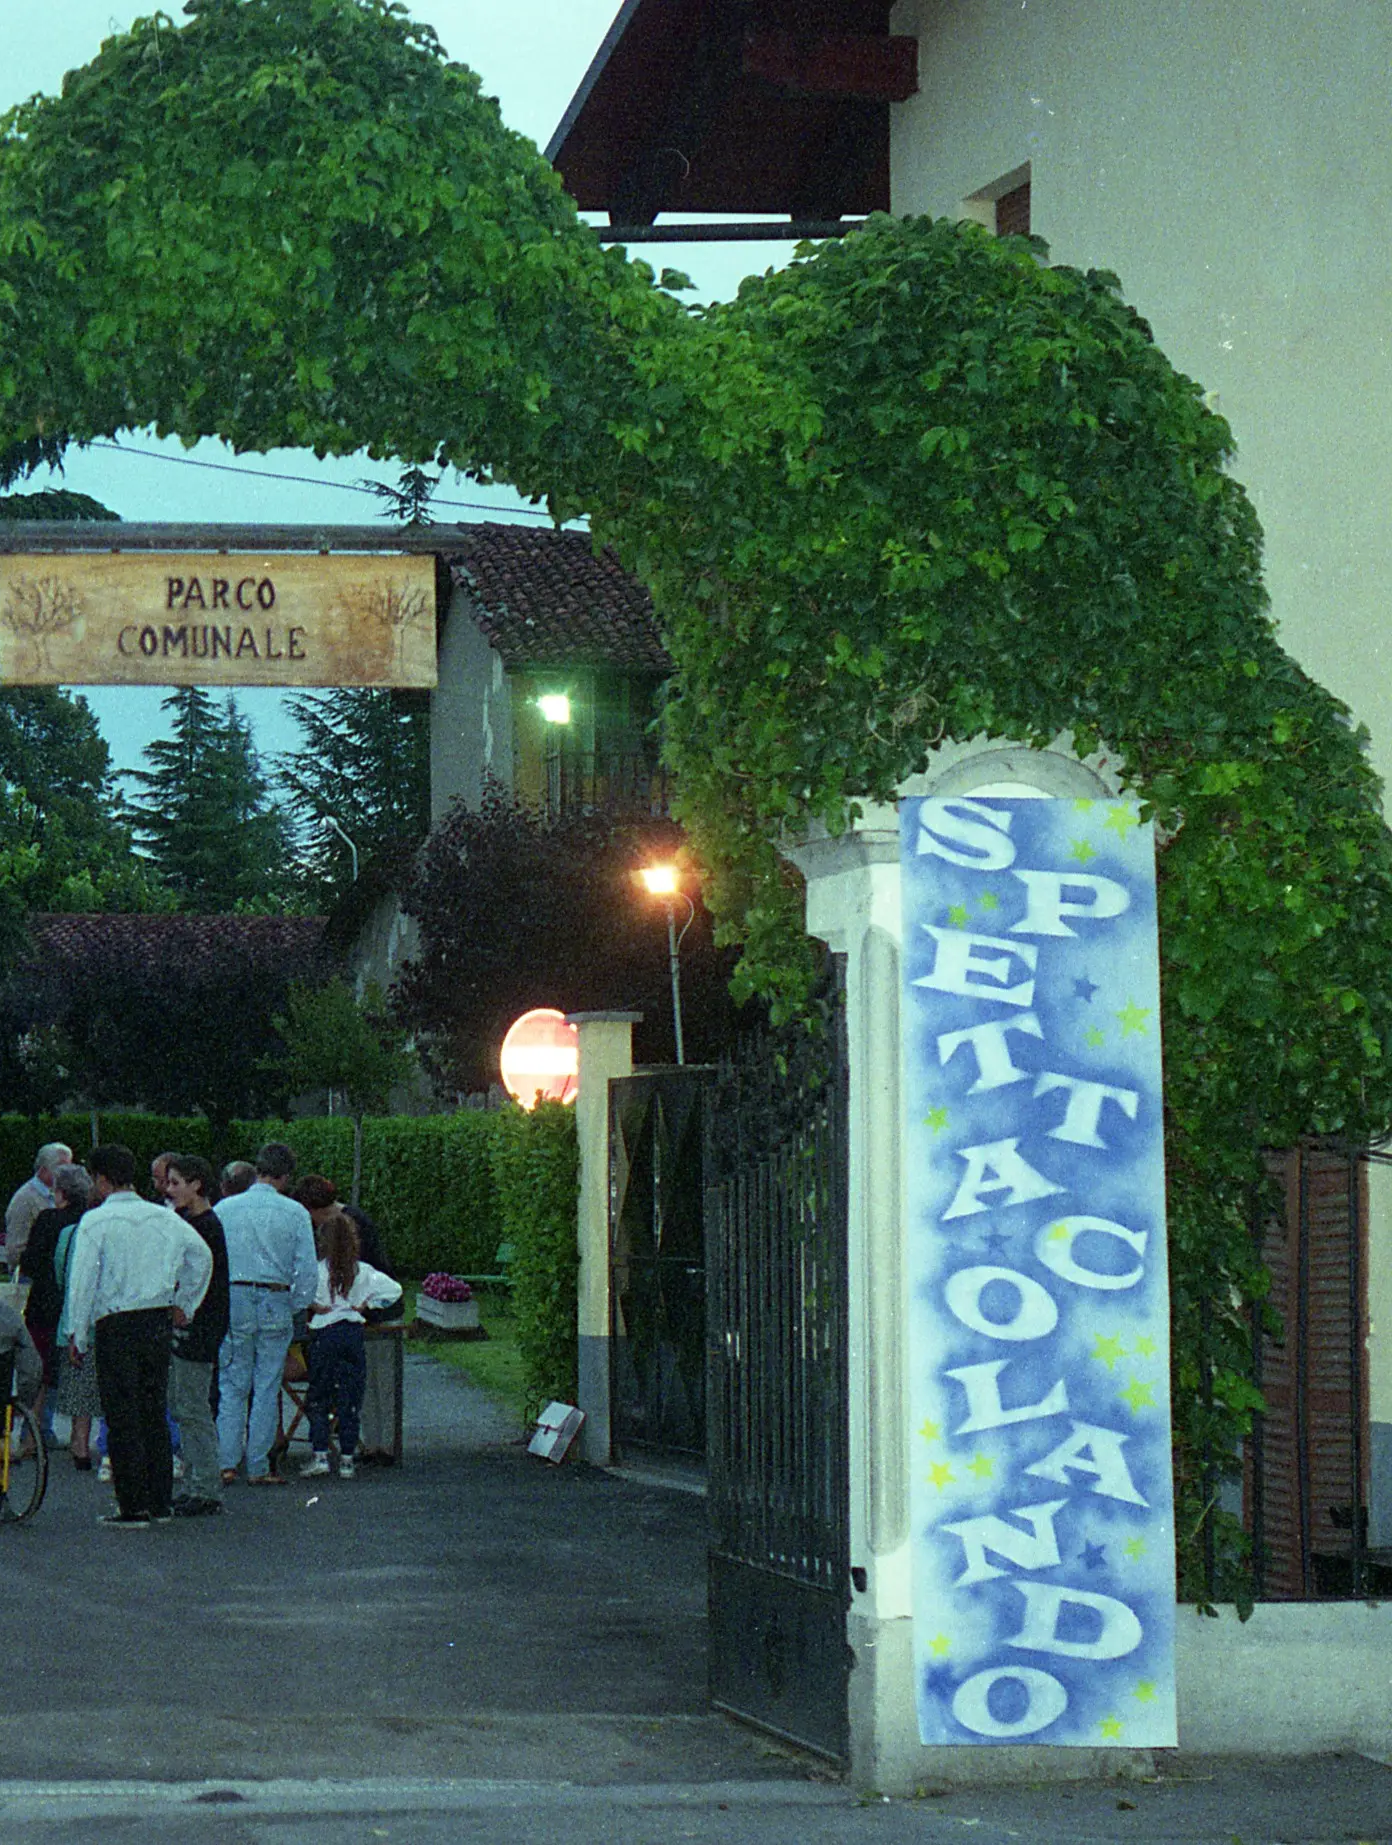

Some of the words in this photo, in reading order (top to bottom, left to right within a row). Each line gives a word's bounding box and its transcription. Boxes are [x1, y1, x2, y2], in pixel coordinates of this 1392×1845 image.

[166, 576, 276, 610] PARCO
[117, 623, 307, 660] COMUNALE
[911, 797, 1150, 1738] SPETTACOLANDO
